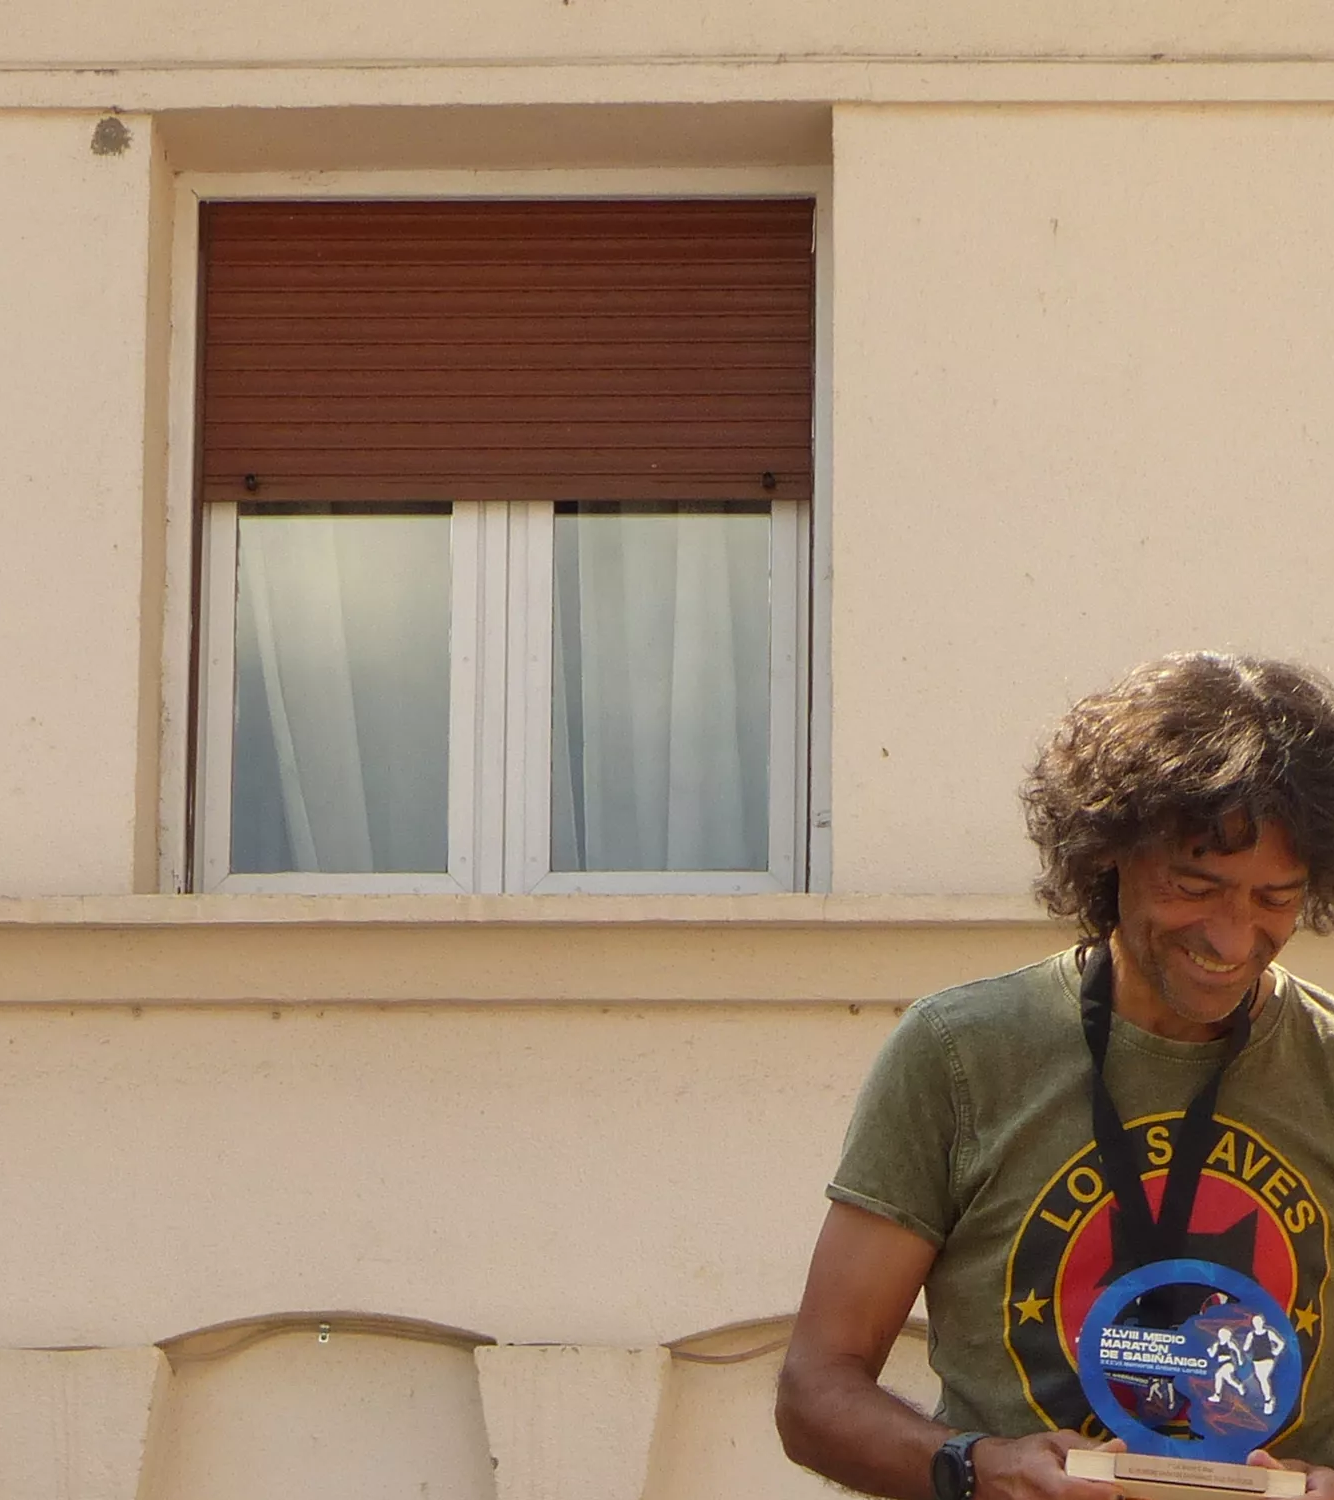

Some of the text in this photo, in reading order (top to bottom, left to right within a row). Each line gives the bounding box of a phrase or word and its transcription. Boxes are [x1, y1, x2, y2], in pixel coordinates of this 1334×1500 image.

[1040, 1126, 1316, 1233] LO SAVES
[1102, 1328, 1186, 1345] XLVIII MEDIO
[1100, 1338, 1169, 1354] MARATÓN
[1100, 1349, 1208, 1369] DE SABIÑÁNIGO
